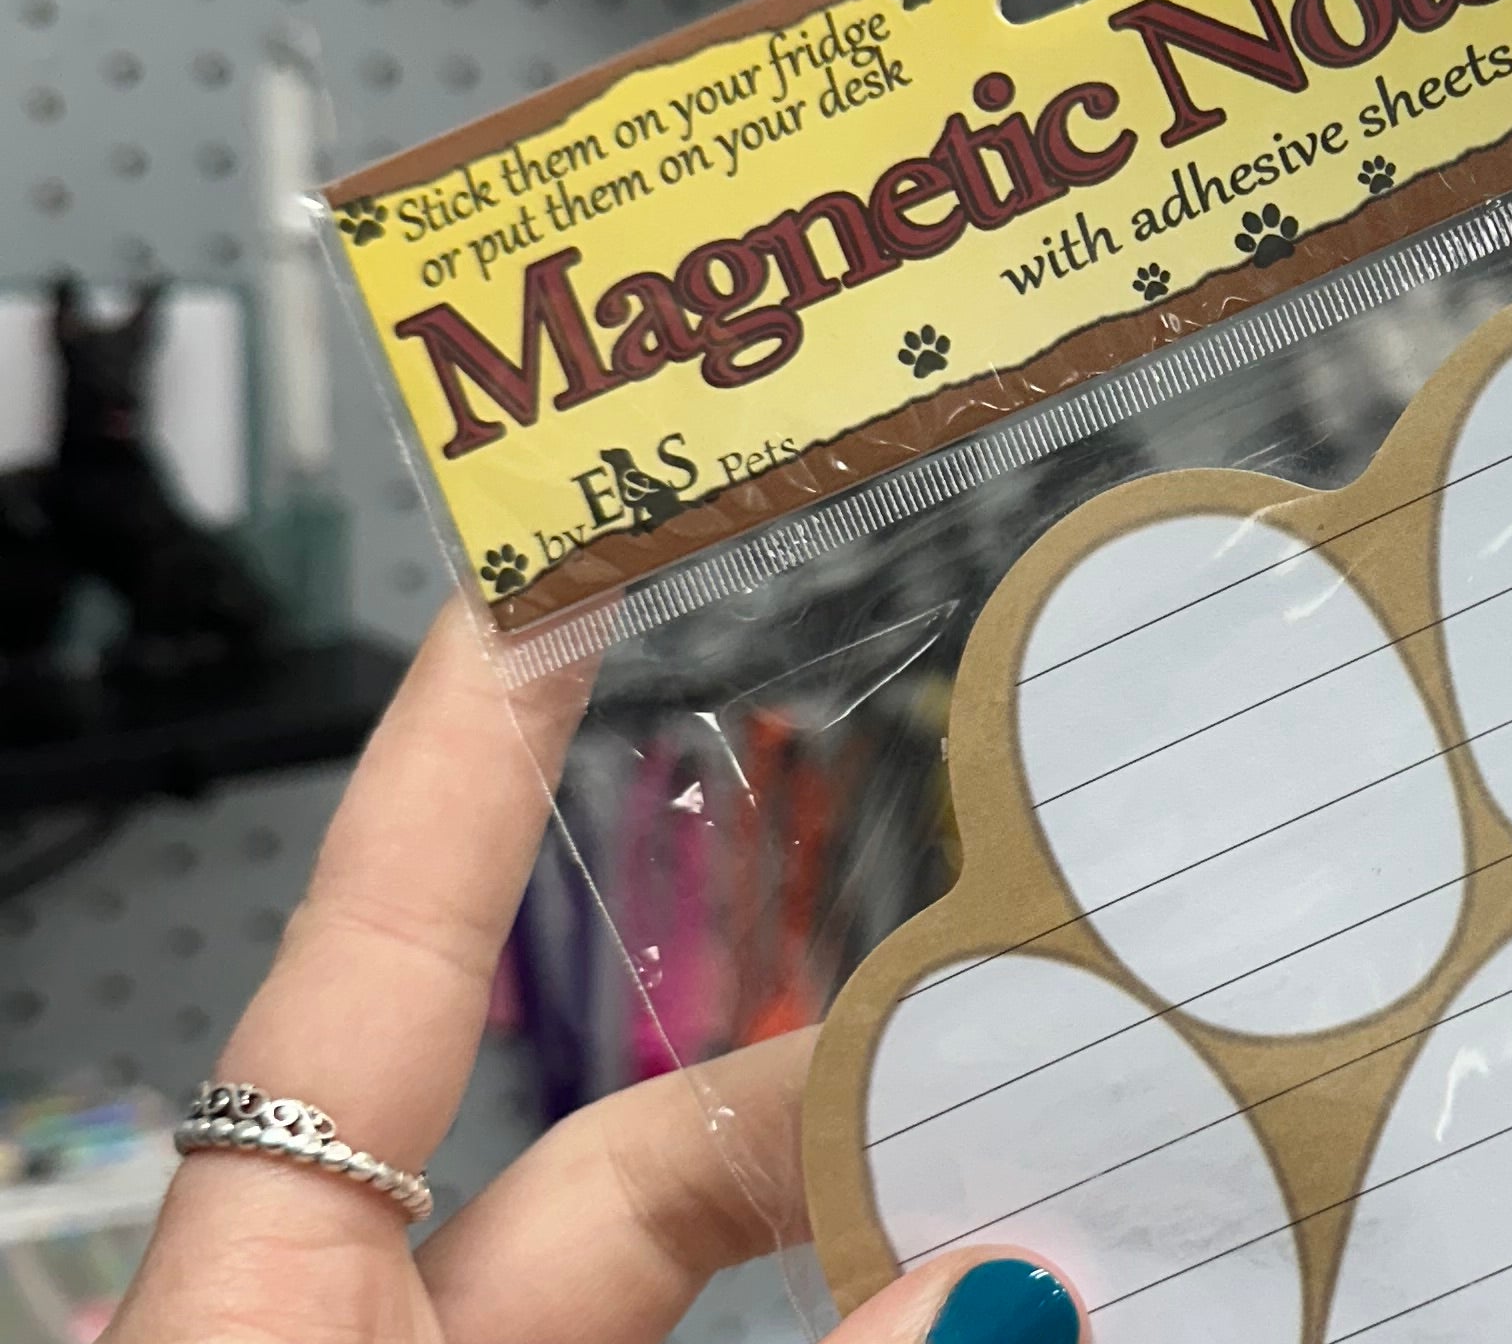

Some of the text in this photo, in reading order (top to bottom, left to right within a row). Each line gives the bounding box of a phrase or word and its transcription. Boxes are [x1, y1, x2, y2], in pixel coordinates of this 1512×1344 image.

[397, 11, 891, 242] Stick them on your fridge
[422, 47, 913, 288] or put them on your desk
[1000, 212, 1124, 295] with
[1130, 122, 1349, 242] adhesive
[395, 72, 1138, 460] Magnetic
[534, 524, 587, 562] by
[717, 437, 801, 485] Pets
